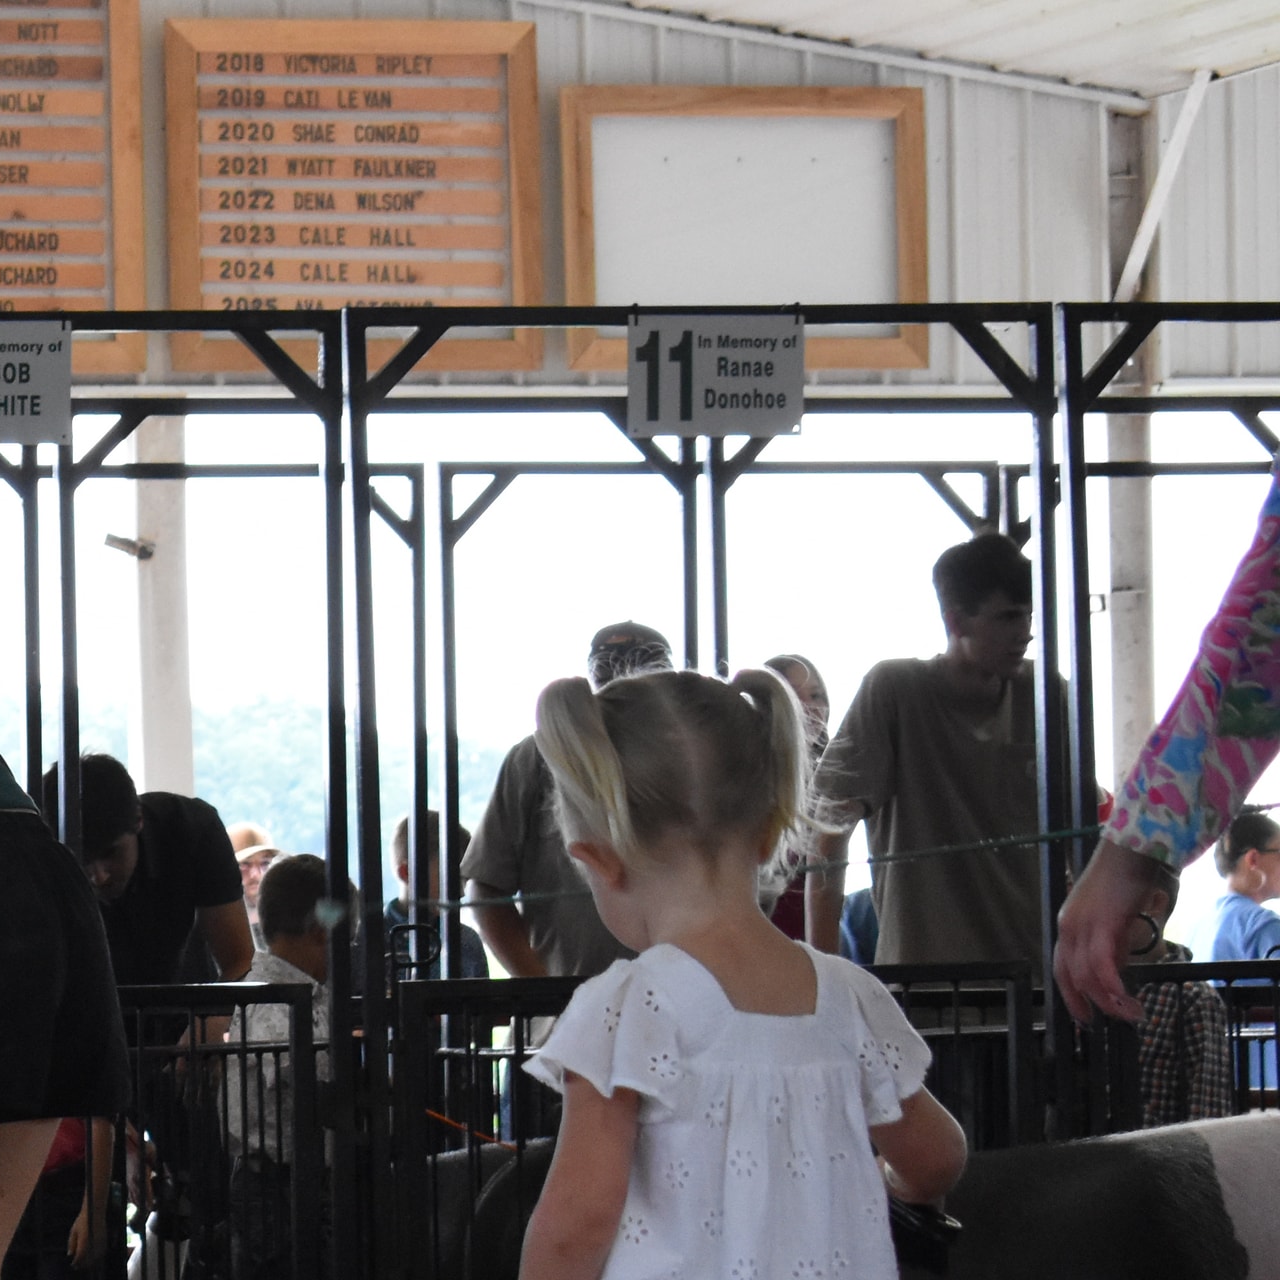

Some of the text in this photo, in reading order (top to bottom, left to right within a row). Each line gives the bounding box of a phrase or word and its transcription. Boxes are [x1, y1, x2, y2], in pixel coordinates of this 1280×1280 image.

[217, 54, 432, 74] 2018 VICTORIA RIPLEY
[219, 124, 420, 143] 2020 SHAE CONRAD
[219, 158, 436, 178] 2021 WYATT FAULKNER
[221, 226, 416, 246] 2023 CALE HALL
[220, 261, 415, 282] 2024 CALE HALL
[47, 341, 63, 353] of
[698, 335, 797, 352] In Memory of
[635, 330, 693, 421] 11
[717, 356, 775, 377] Ranae
[704, 388, 787, 409] Donohoe
